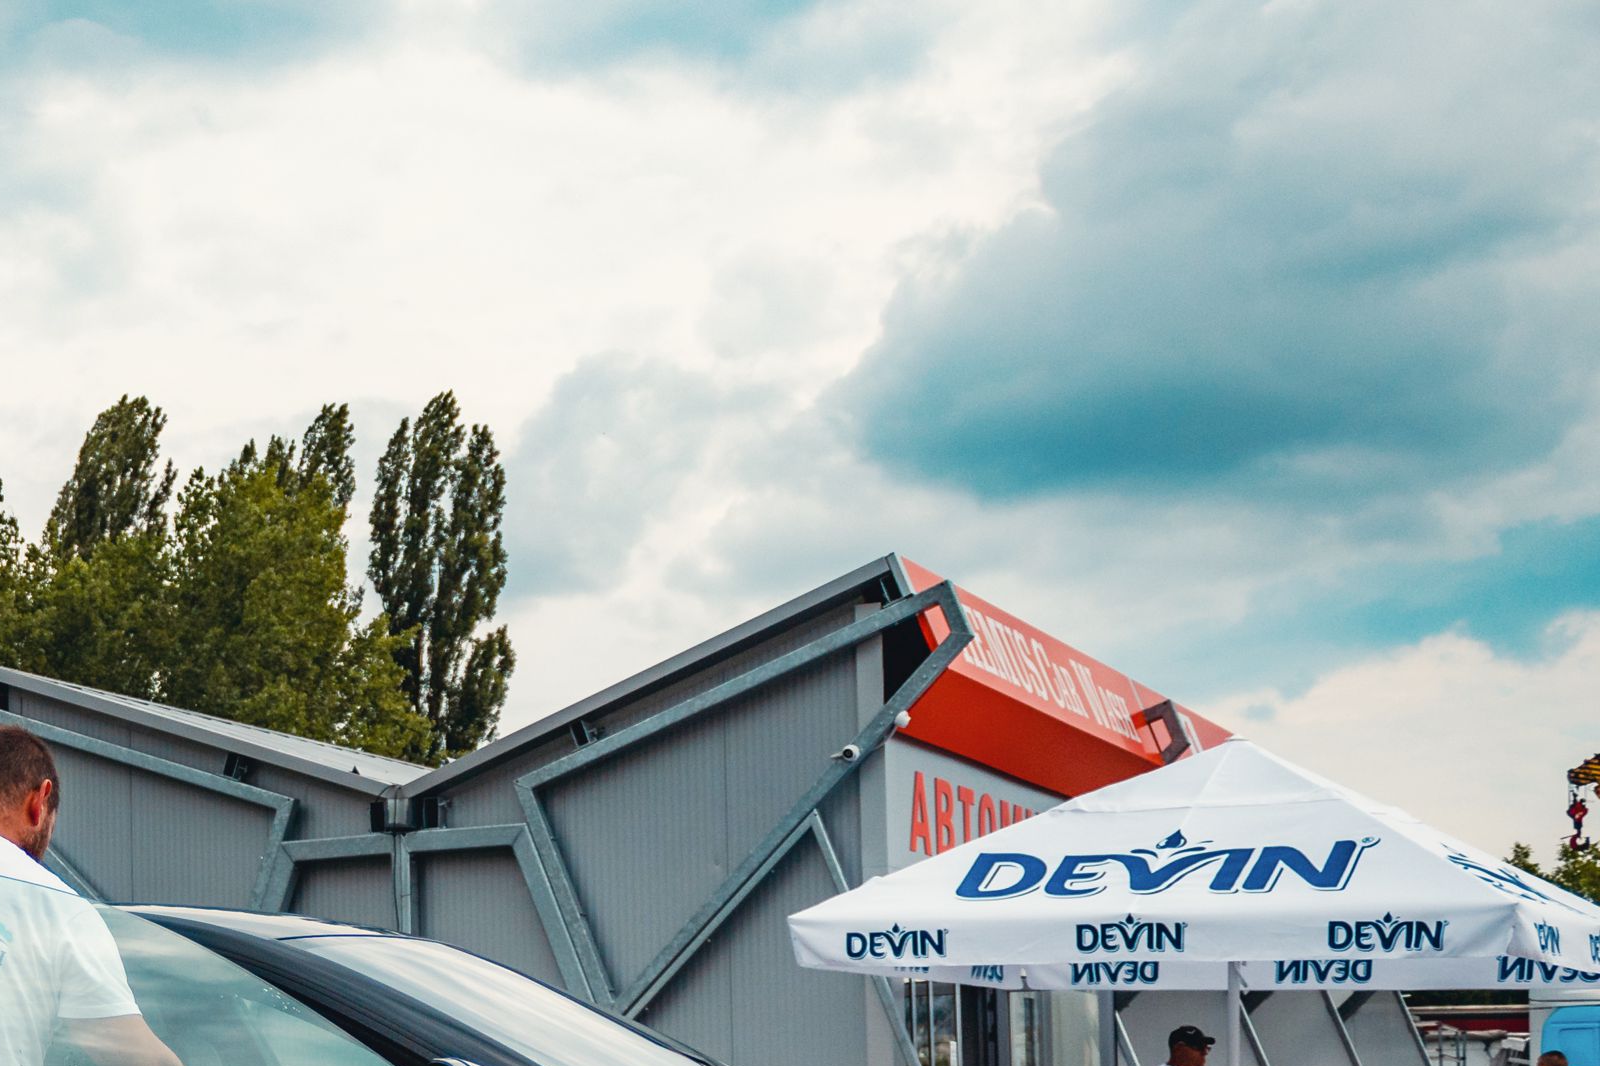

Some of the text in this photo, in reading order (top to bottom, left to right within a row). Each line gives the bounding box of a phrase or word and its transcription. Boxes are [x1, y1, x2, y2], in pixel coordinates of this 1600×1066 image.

[955, 838, 1368, 900] DEVIN
[845, 927, 946, 960] DEVIN
[1075, 922, 1184, 953] DEVIN
[1327, 919, 1444, 951] DEVIN
